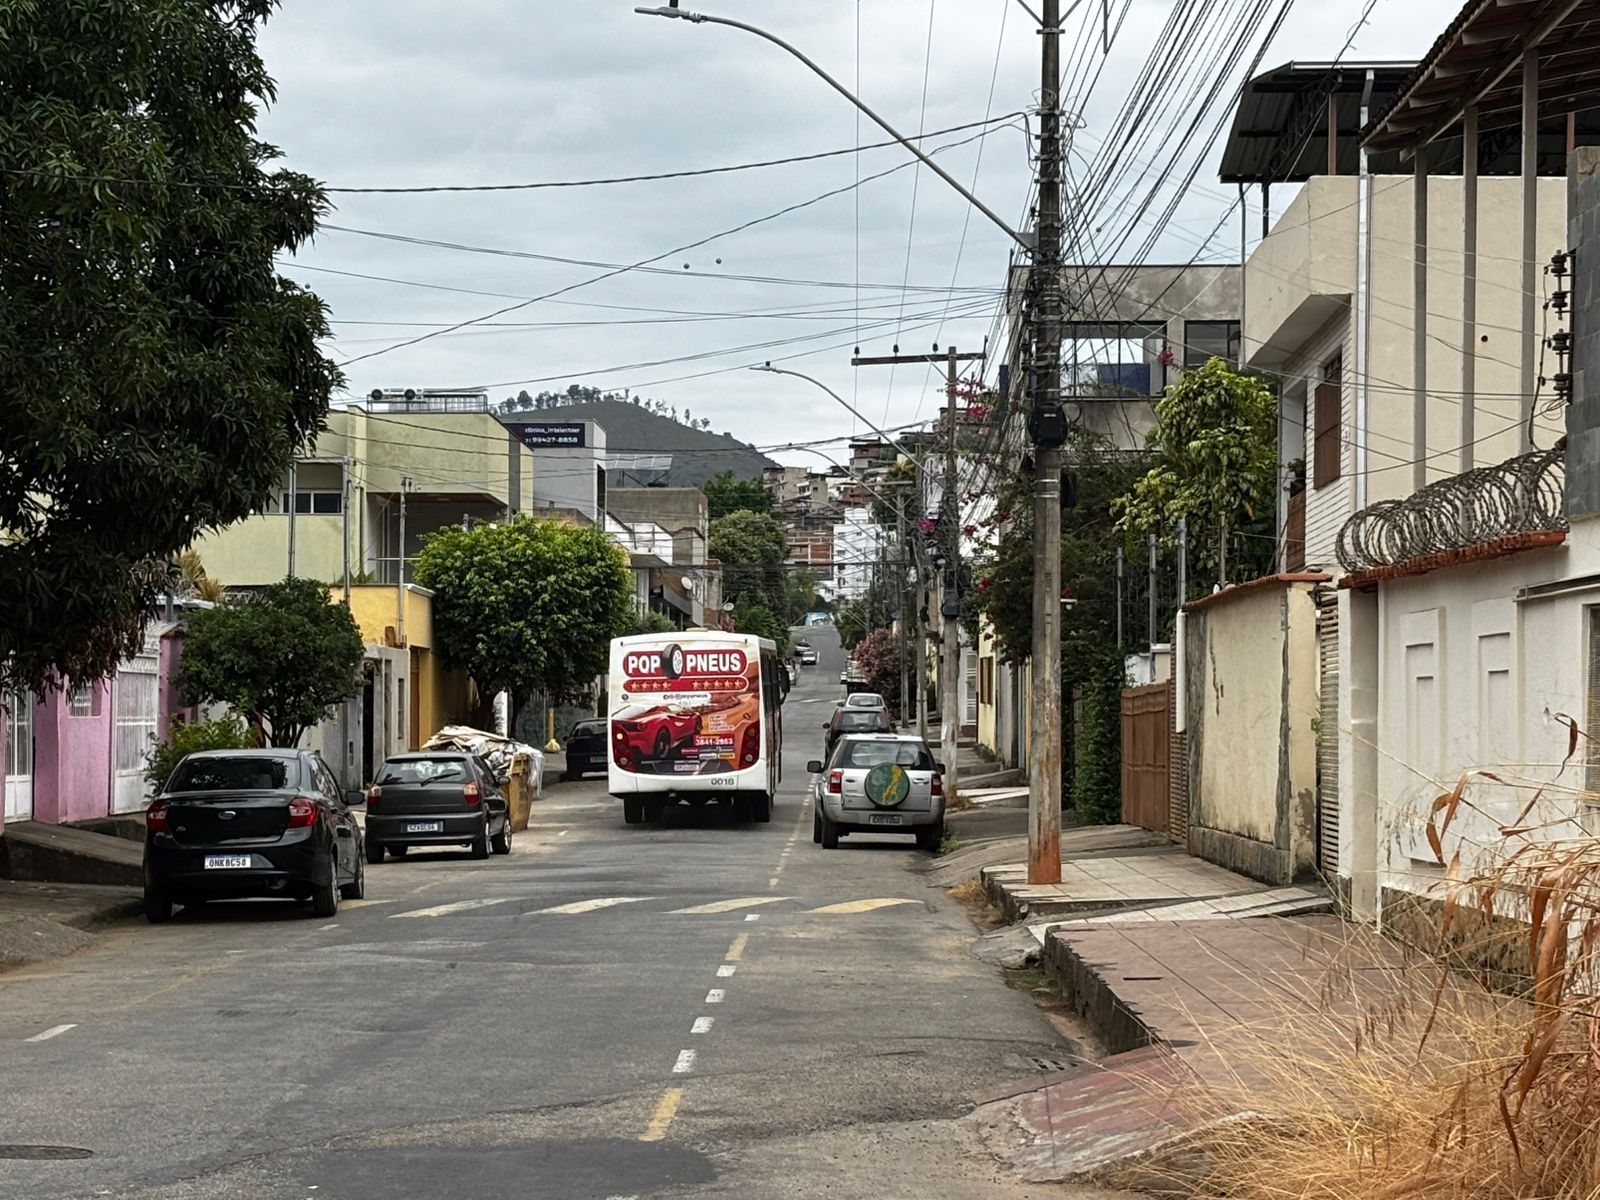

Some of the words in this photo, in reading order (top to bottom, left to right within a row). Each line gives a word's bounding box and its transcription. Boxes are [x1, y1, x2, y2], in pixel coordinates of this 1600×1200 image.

[628, 655, 660, 674] POP
[686, 653, 741, 672] PNEUS
[711, 778, 735, 786] 0018
